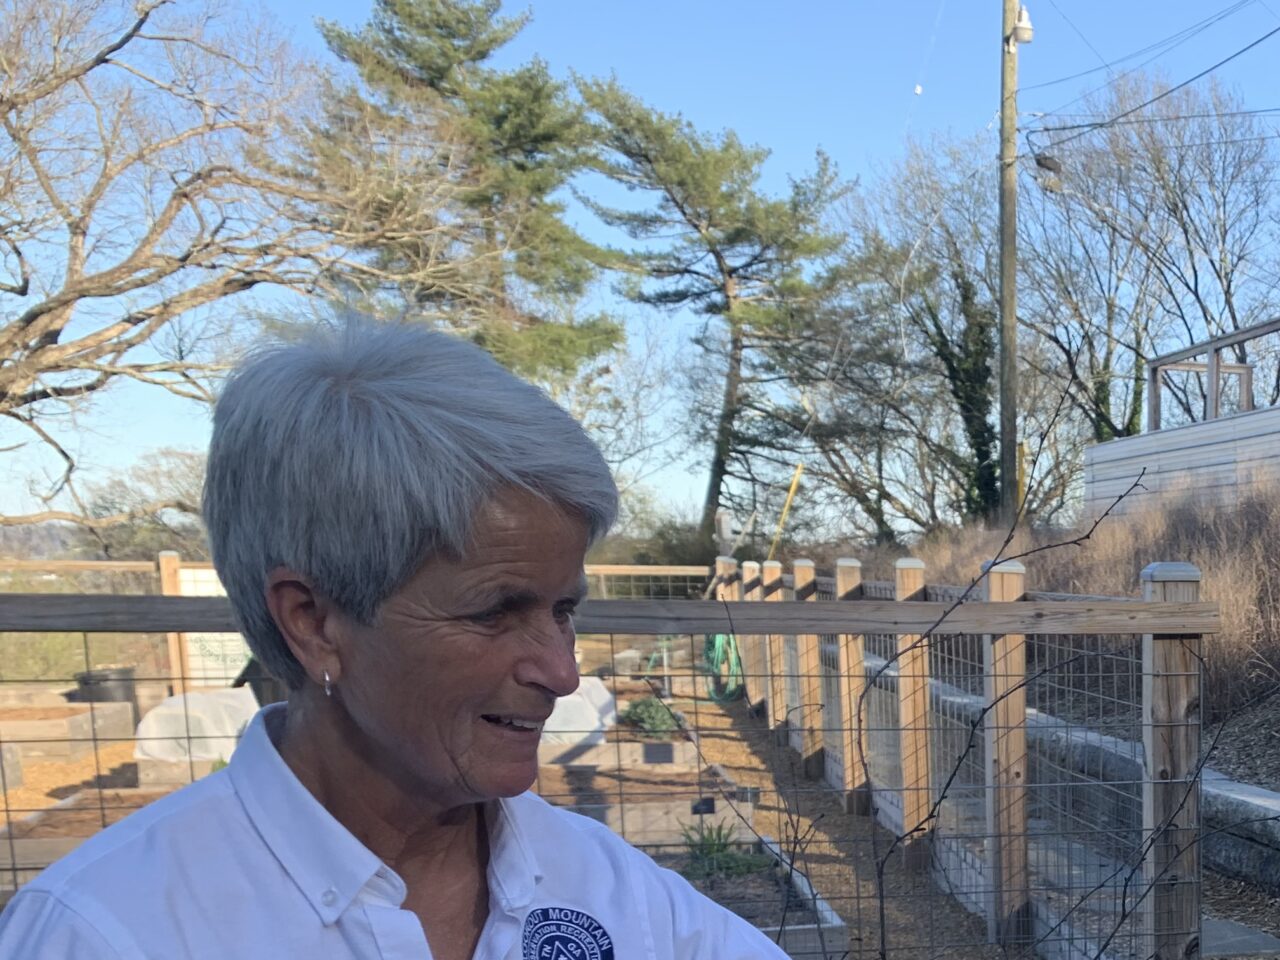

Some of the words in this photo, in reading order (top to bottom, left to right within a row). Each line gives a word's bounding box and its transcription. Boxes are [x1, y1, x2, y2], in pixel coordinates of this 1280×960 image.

[548, 908, 612, 951] MOUNTAIN
[541, 944, 552, 958] TN
[567, 942, 582, 957] GA
